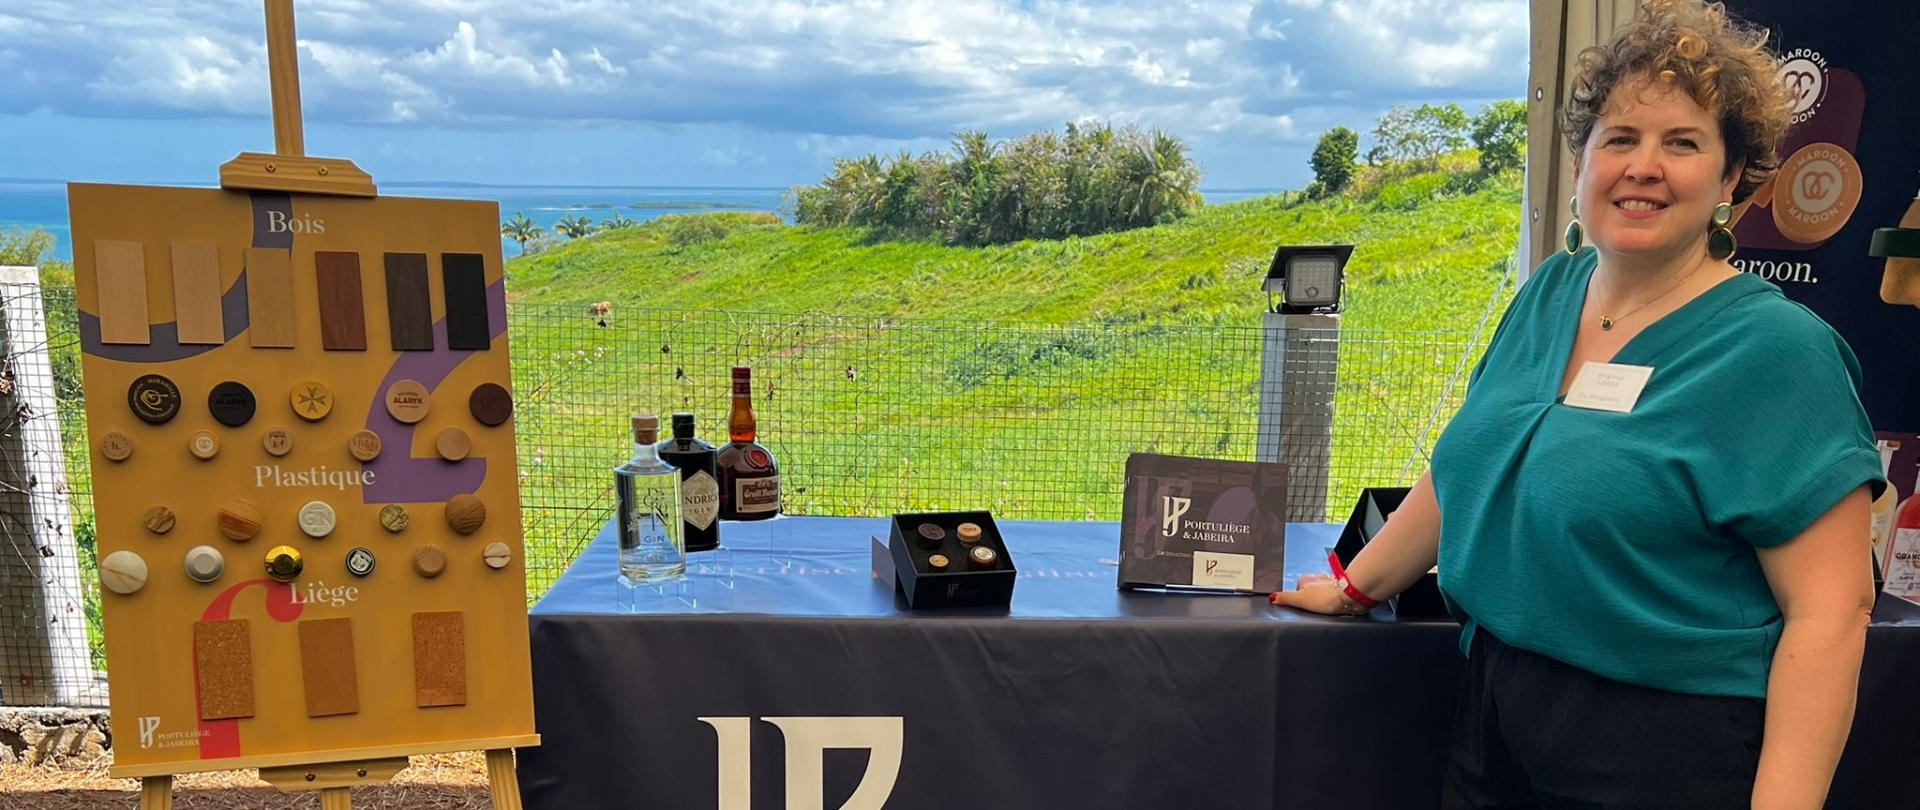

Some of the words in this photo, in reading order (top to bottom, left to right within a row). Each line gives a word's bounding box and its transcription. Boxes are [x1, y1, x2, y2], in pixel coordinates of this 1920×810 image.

[1777, 48, 1827, 68] MAROON
[1790, 107, 1816, 125] OON
[1797, 149, 1847, 168] MAROON
[266, 210, 325, 234] Bois
[1787, 206, 1840, 224] MAROON
[1732, 258, 1818, 283] aroon.
[393, 396, 424, 405] ALARYK
[254, 465, 376, 491] Plastique
[1184, 520, 1250, 534] PORTULIÈGE
[644, 535, 665, 543] GIN
[1183, 531, 1191, 540] &
[1192, 532, 1235, 543] JABEIRA
[290, 581, 359, 607] Liège
